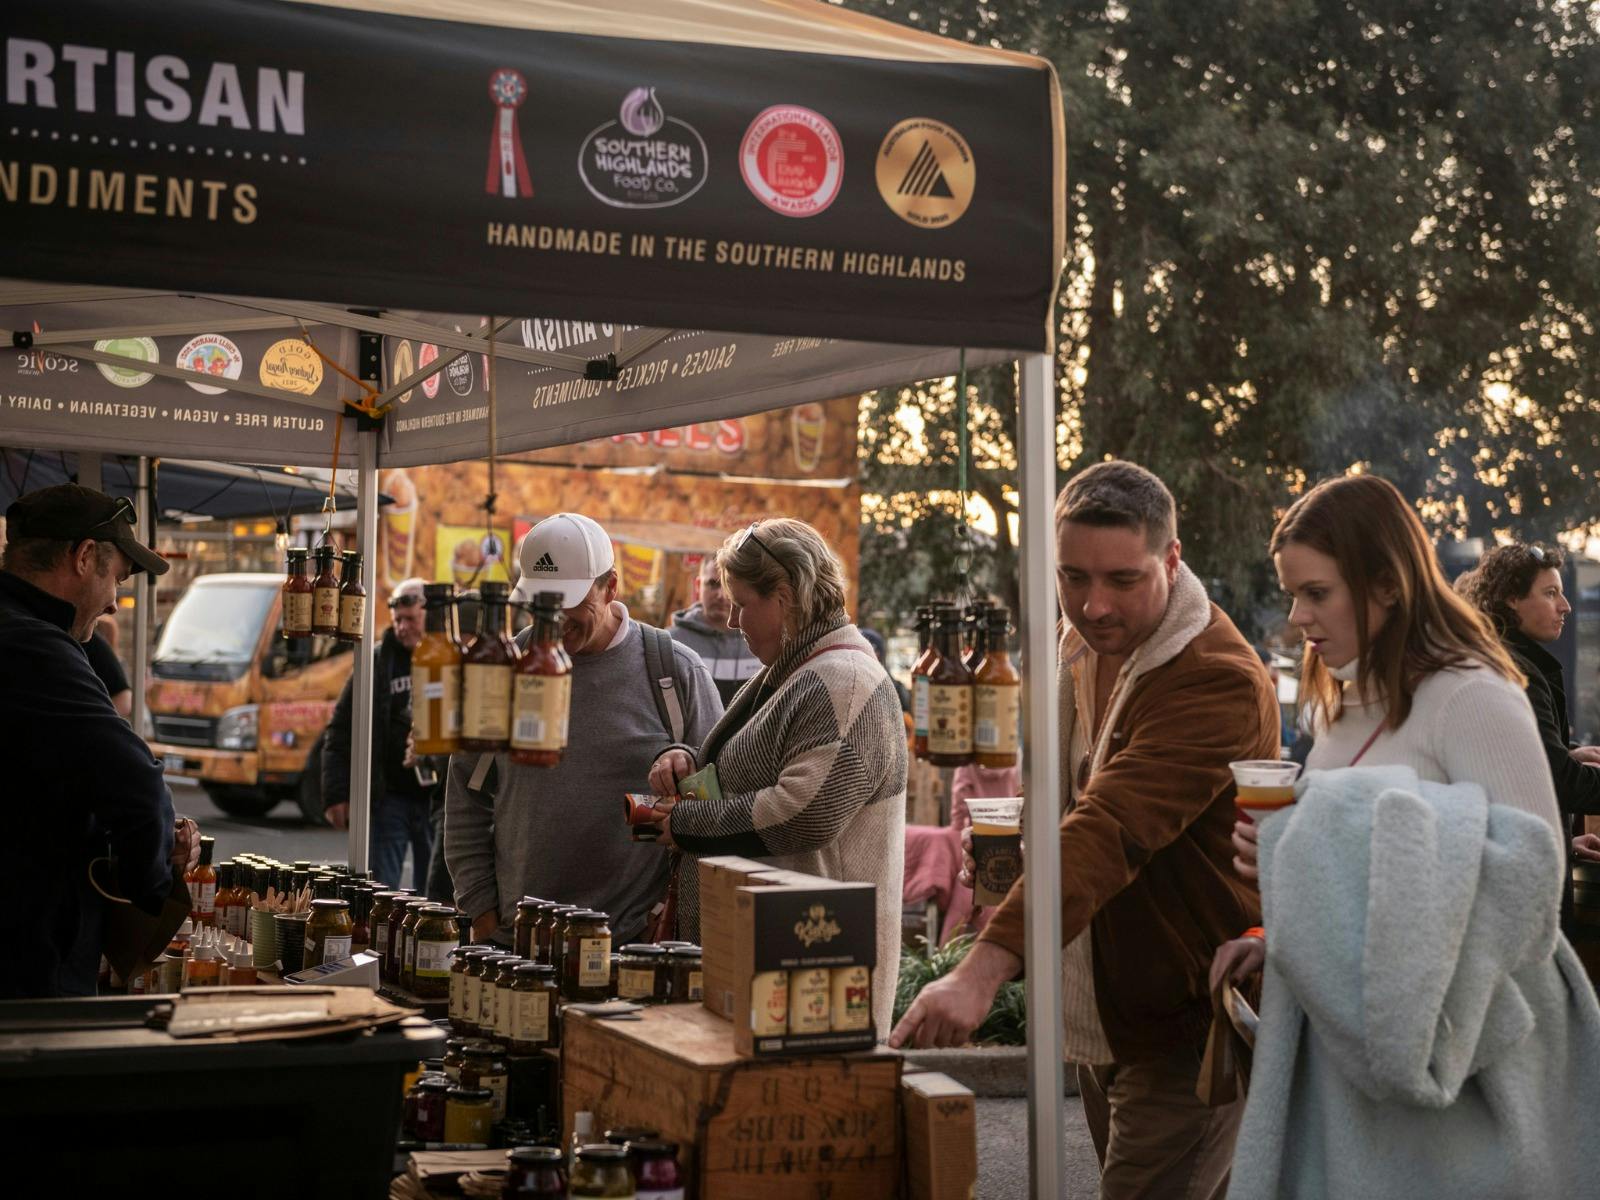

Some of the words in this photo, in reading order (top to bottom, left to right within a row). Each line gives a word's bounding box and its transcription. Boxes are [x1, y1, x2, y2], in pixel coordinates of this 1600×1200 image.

[594, 137, 691, 161] SOUTHERN
[748, 110, 814, 155] INTERNATIONAL
[595, 153, 693, 180] HIGHLANDS
[0, 160, 258, 225] NDIMENTS
[772, 195, 817, 210] AWARDS
[487, 222, 621, 257] HANDMADE
[630, 234, 654, 257] IN
[665, 236, 707, 263] THE
[715, 240, 835, 271] SOUTHERN
[843, 252, 967, 283] HIGHLANDS
